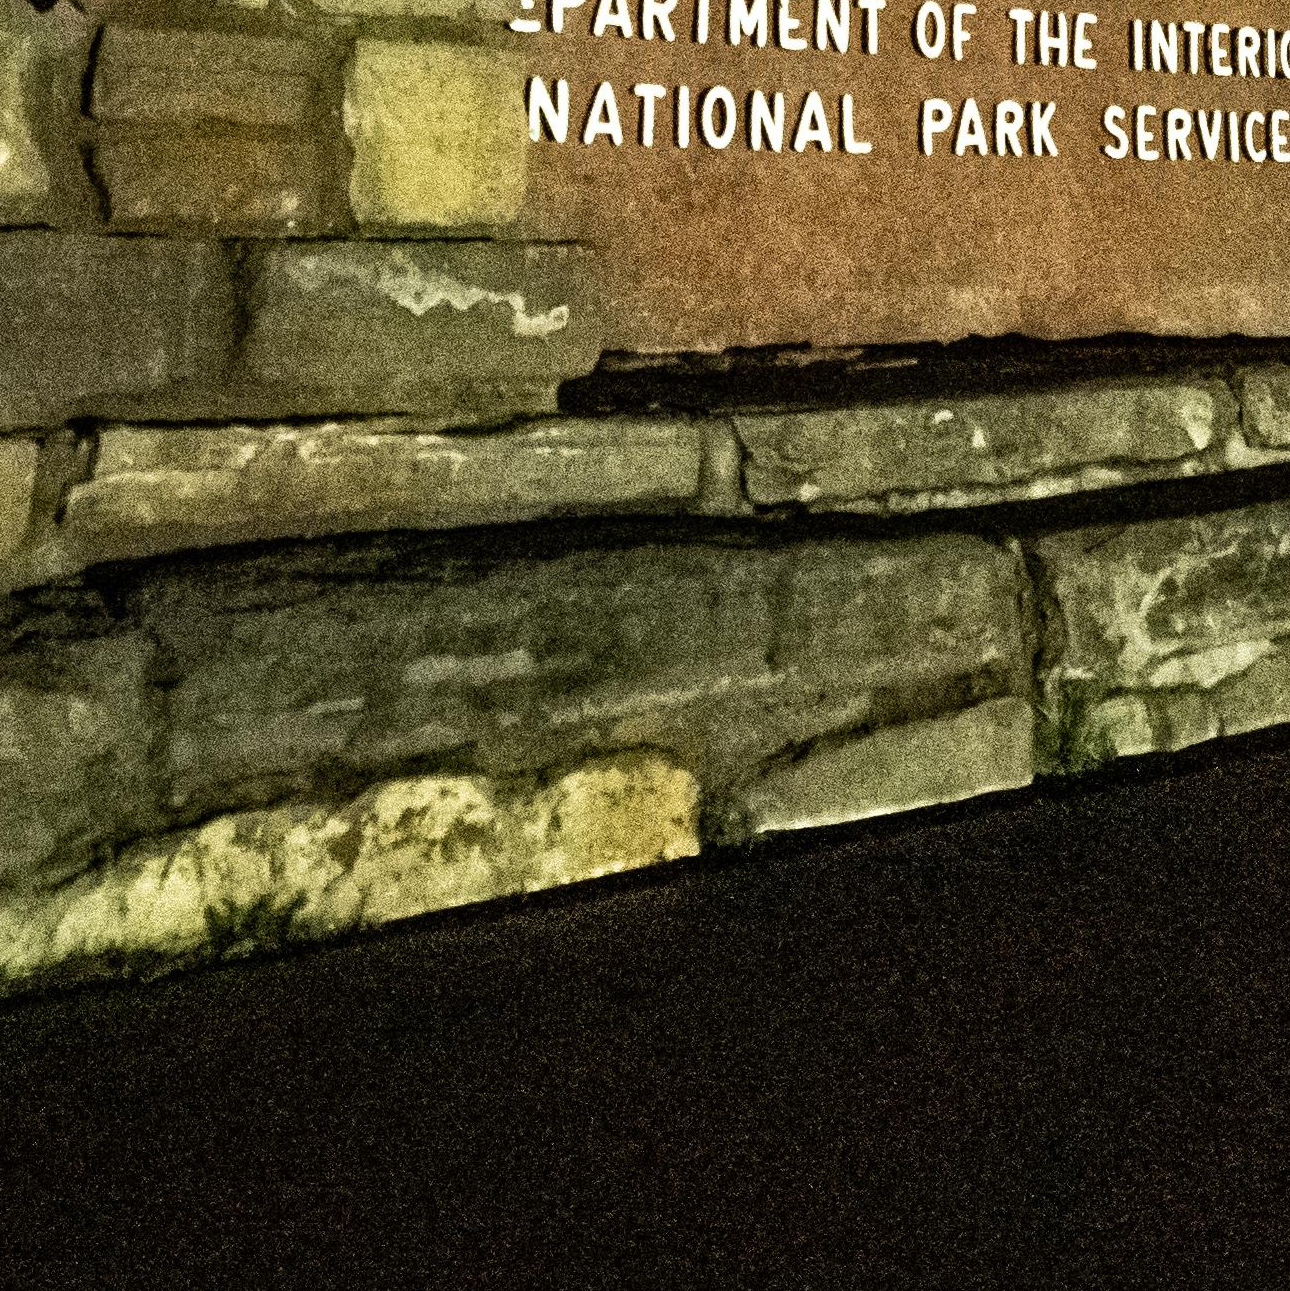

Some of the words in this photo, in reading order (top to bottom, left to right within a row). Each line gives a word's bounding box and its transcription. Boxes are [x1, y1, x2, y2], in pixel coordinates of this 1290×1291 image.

[916, 1, 976, 60] OF
[1010, 7, 1098, 70] THE
[527, 77, 872, 155] NATIONAL
[921, 98, 1059, 158] PARK
